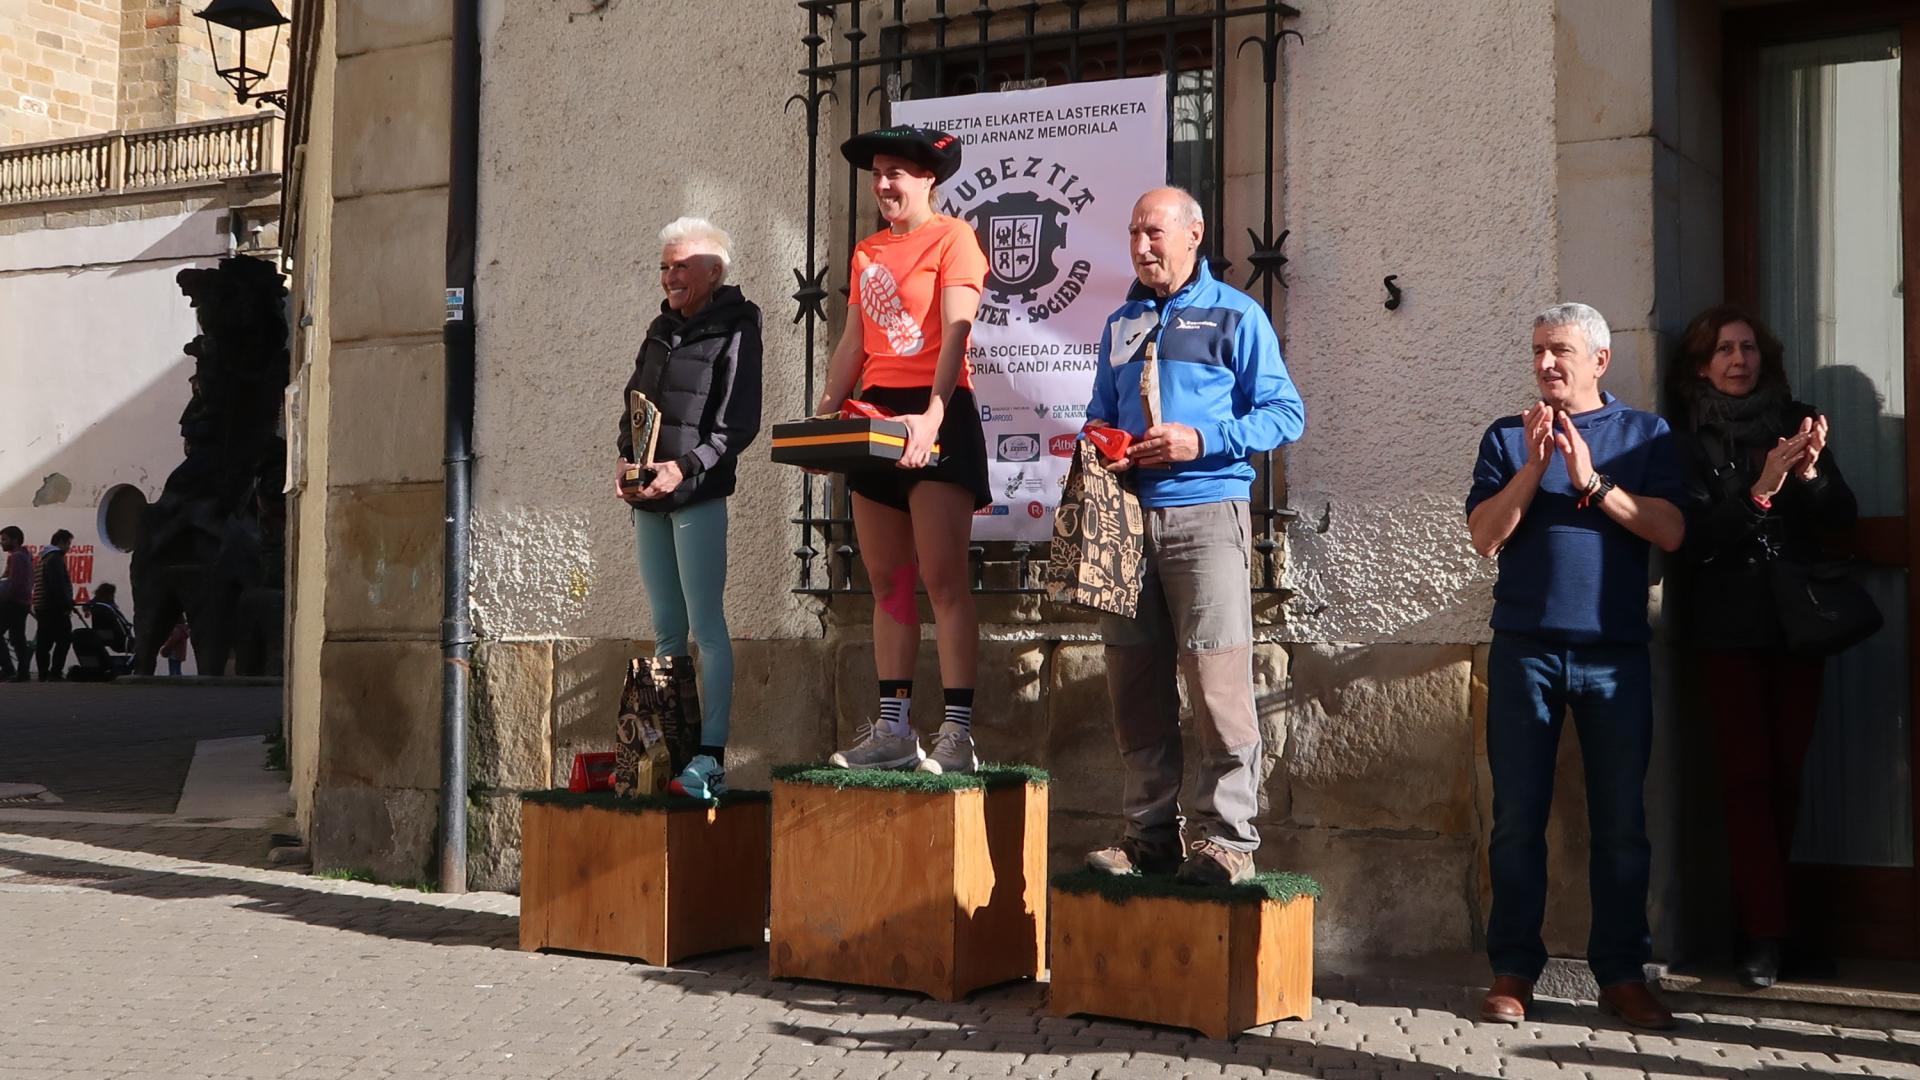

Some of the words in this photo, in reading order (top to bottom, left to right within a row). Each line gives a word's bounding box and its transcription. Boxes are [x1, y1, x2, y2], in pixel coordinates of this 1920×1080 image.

[922, 117, 982, 131] ZUBEZTIA
[985, 110, 1054, 127] ELKARTEA
[1057, 102, 1147, 120] LASTERKETA
[958, 133, 978, 146] NDI
[981, 128, 1035, 144] ARNANZ
[1038, 121, 1118, 139] MEMORIALA
[975, 304, 1010, 327] TEA
[990, 344, 1060, 357] SOCIEDAD
[1063, 343, 1101, 355] ZUBE
[970, 363, 1004, 376] ORIAL
[1007, 361, 1049, 374] CANDI
[1052, 360, 1099, 372] ARNAN
[1052, 404, 1070, 412] CAJA
[1052, 411, 1063, 419] DE
